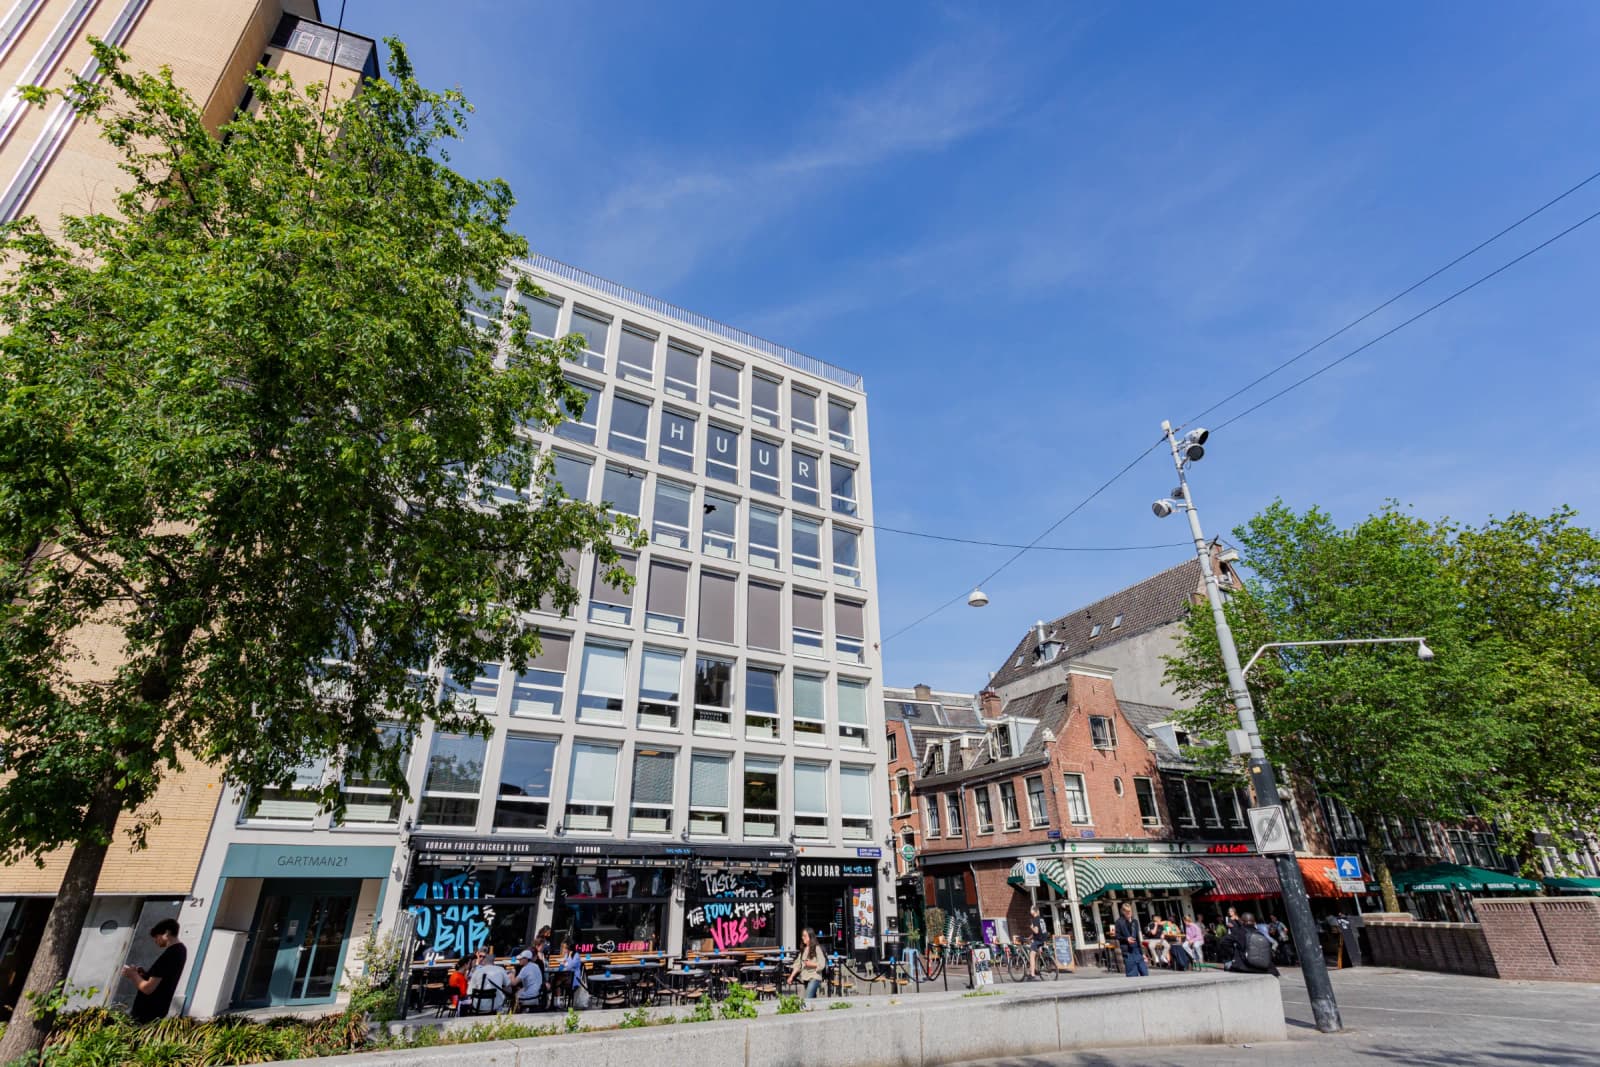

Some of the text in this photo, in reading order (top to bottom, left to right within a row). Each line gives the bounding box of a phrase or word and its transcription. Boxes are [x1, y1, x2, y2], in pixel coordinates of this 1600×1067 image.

[425, 841, 452, 849] KOREAN
[454, 842, 475, 850] FRIED
[476, 843, 504, 851] CHICKEN
[513, 844, 529, 852] BEER
[277, 856, 348, 867] GARTMAN21
[701, 870, 738, 896] TASTE
[189, 897, 205, 908] 21
[687, 906, 704, 928] THE
[434, 919, 490, 957] BAR
[617, 942, 649, 951] EVERYDAY
